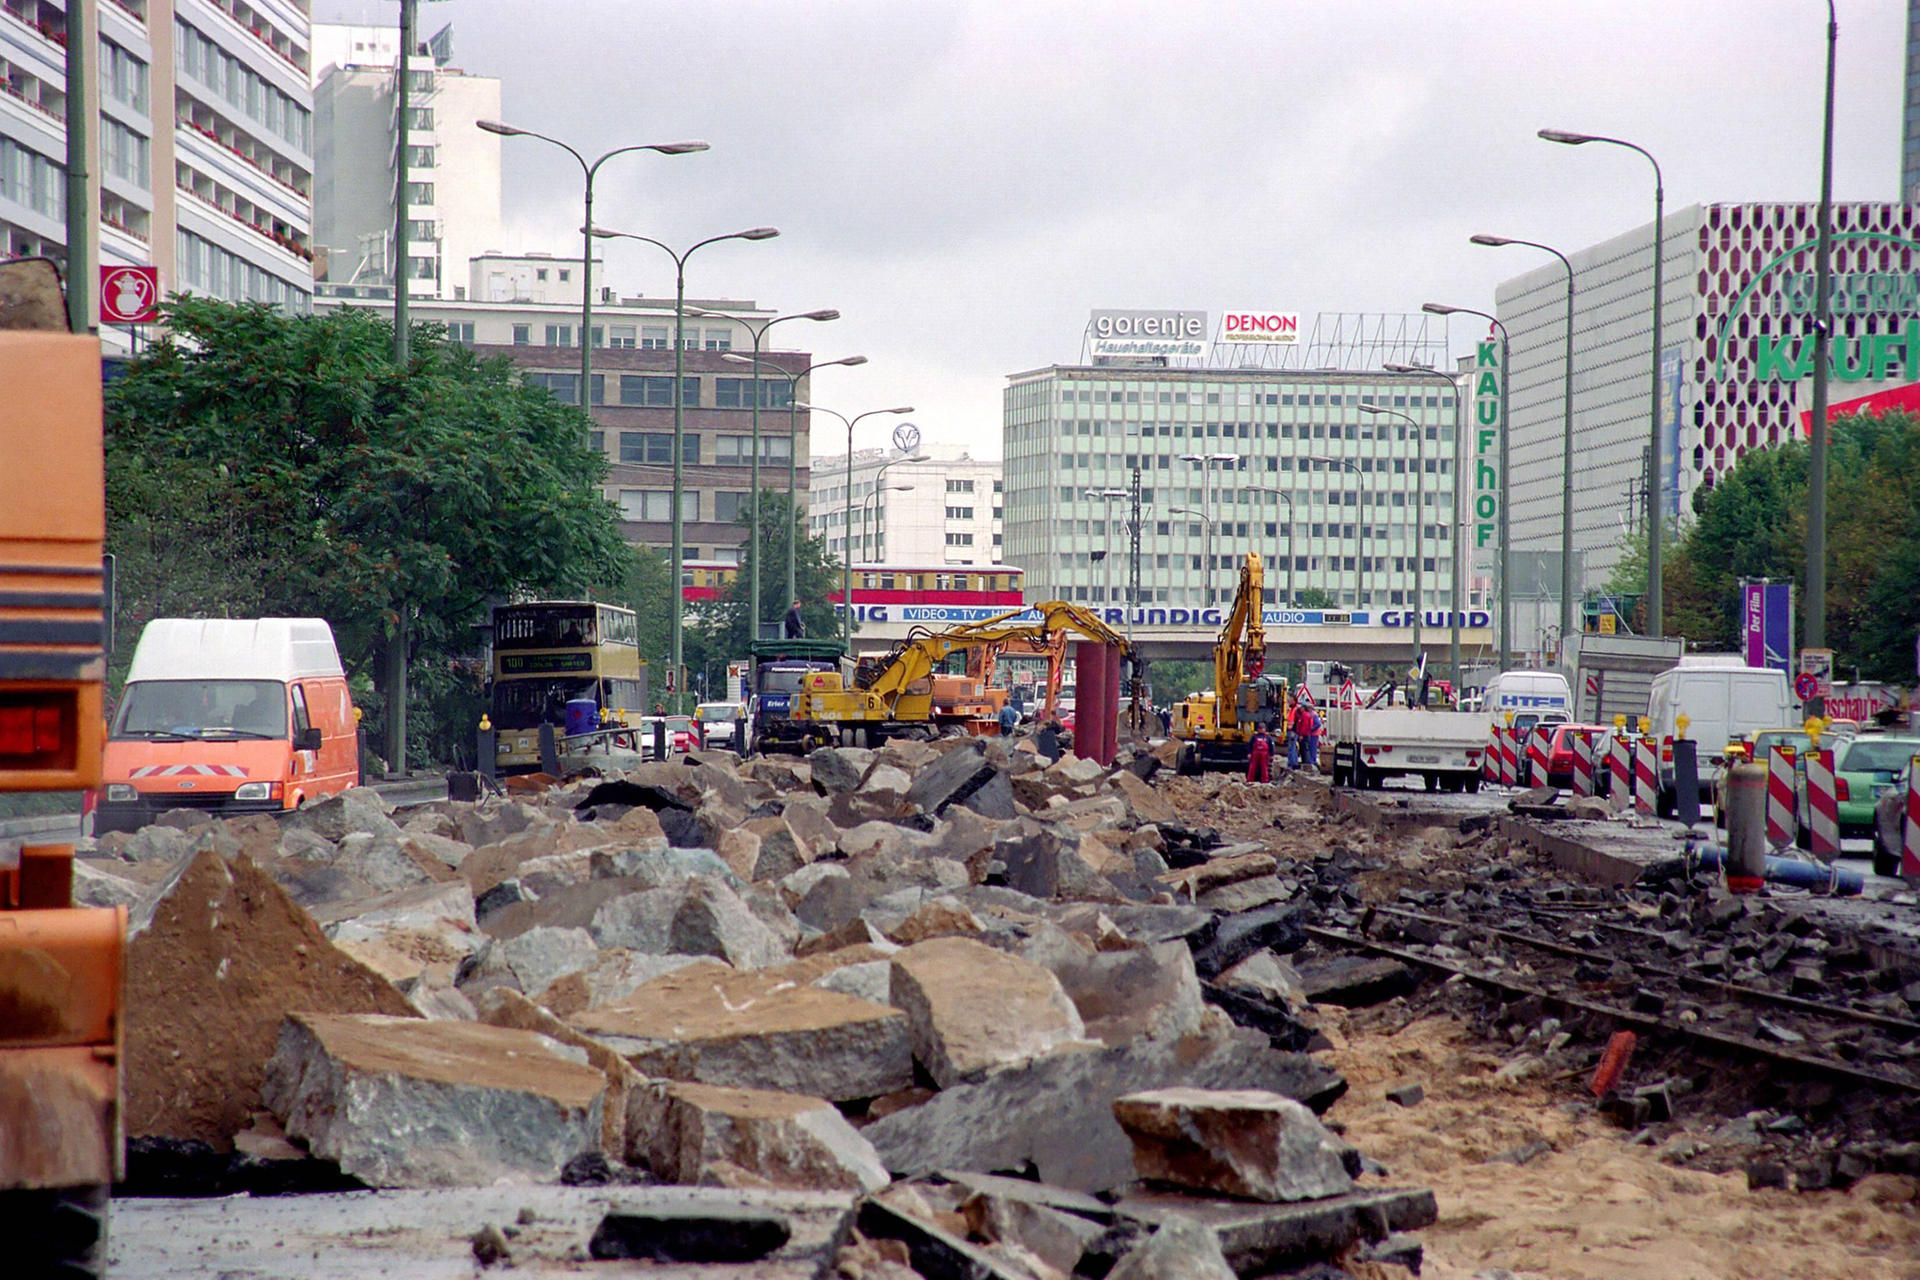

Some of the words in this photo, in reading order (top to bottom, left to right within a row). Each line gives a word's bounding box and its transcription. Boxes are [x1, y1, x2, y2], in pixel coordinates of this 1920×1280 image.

[1789, 273, 1919, 313] GLERIA
[1096, 312, 1202, 340] gorenje
[1226, 314, 1297, 332] DENON
[1750, 591, 1761, 613] Film
[908, 608, 948, 620] VIDEO
[962, 609, 977, 620] TV
[1091, 607, 1222, 626] RUNDIG
[1264, 612, 1305, 623] AUDIO
[1750, 613, 1761, 633] Der
[867, 697, 875, 709] 6
